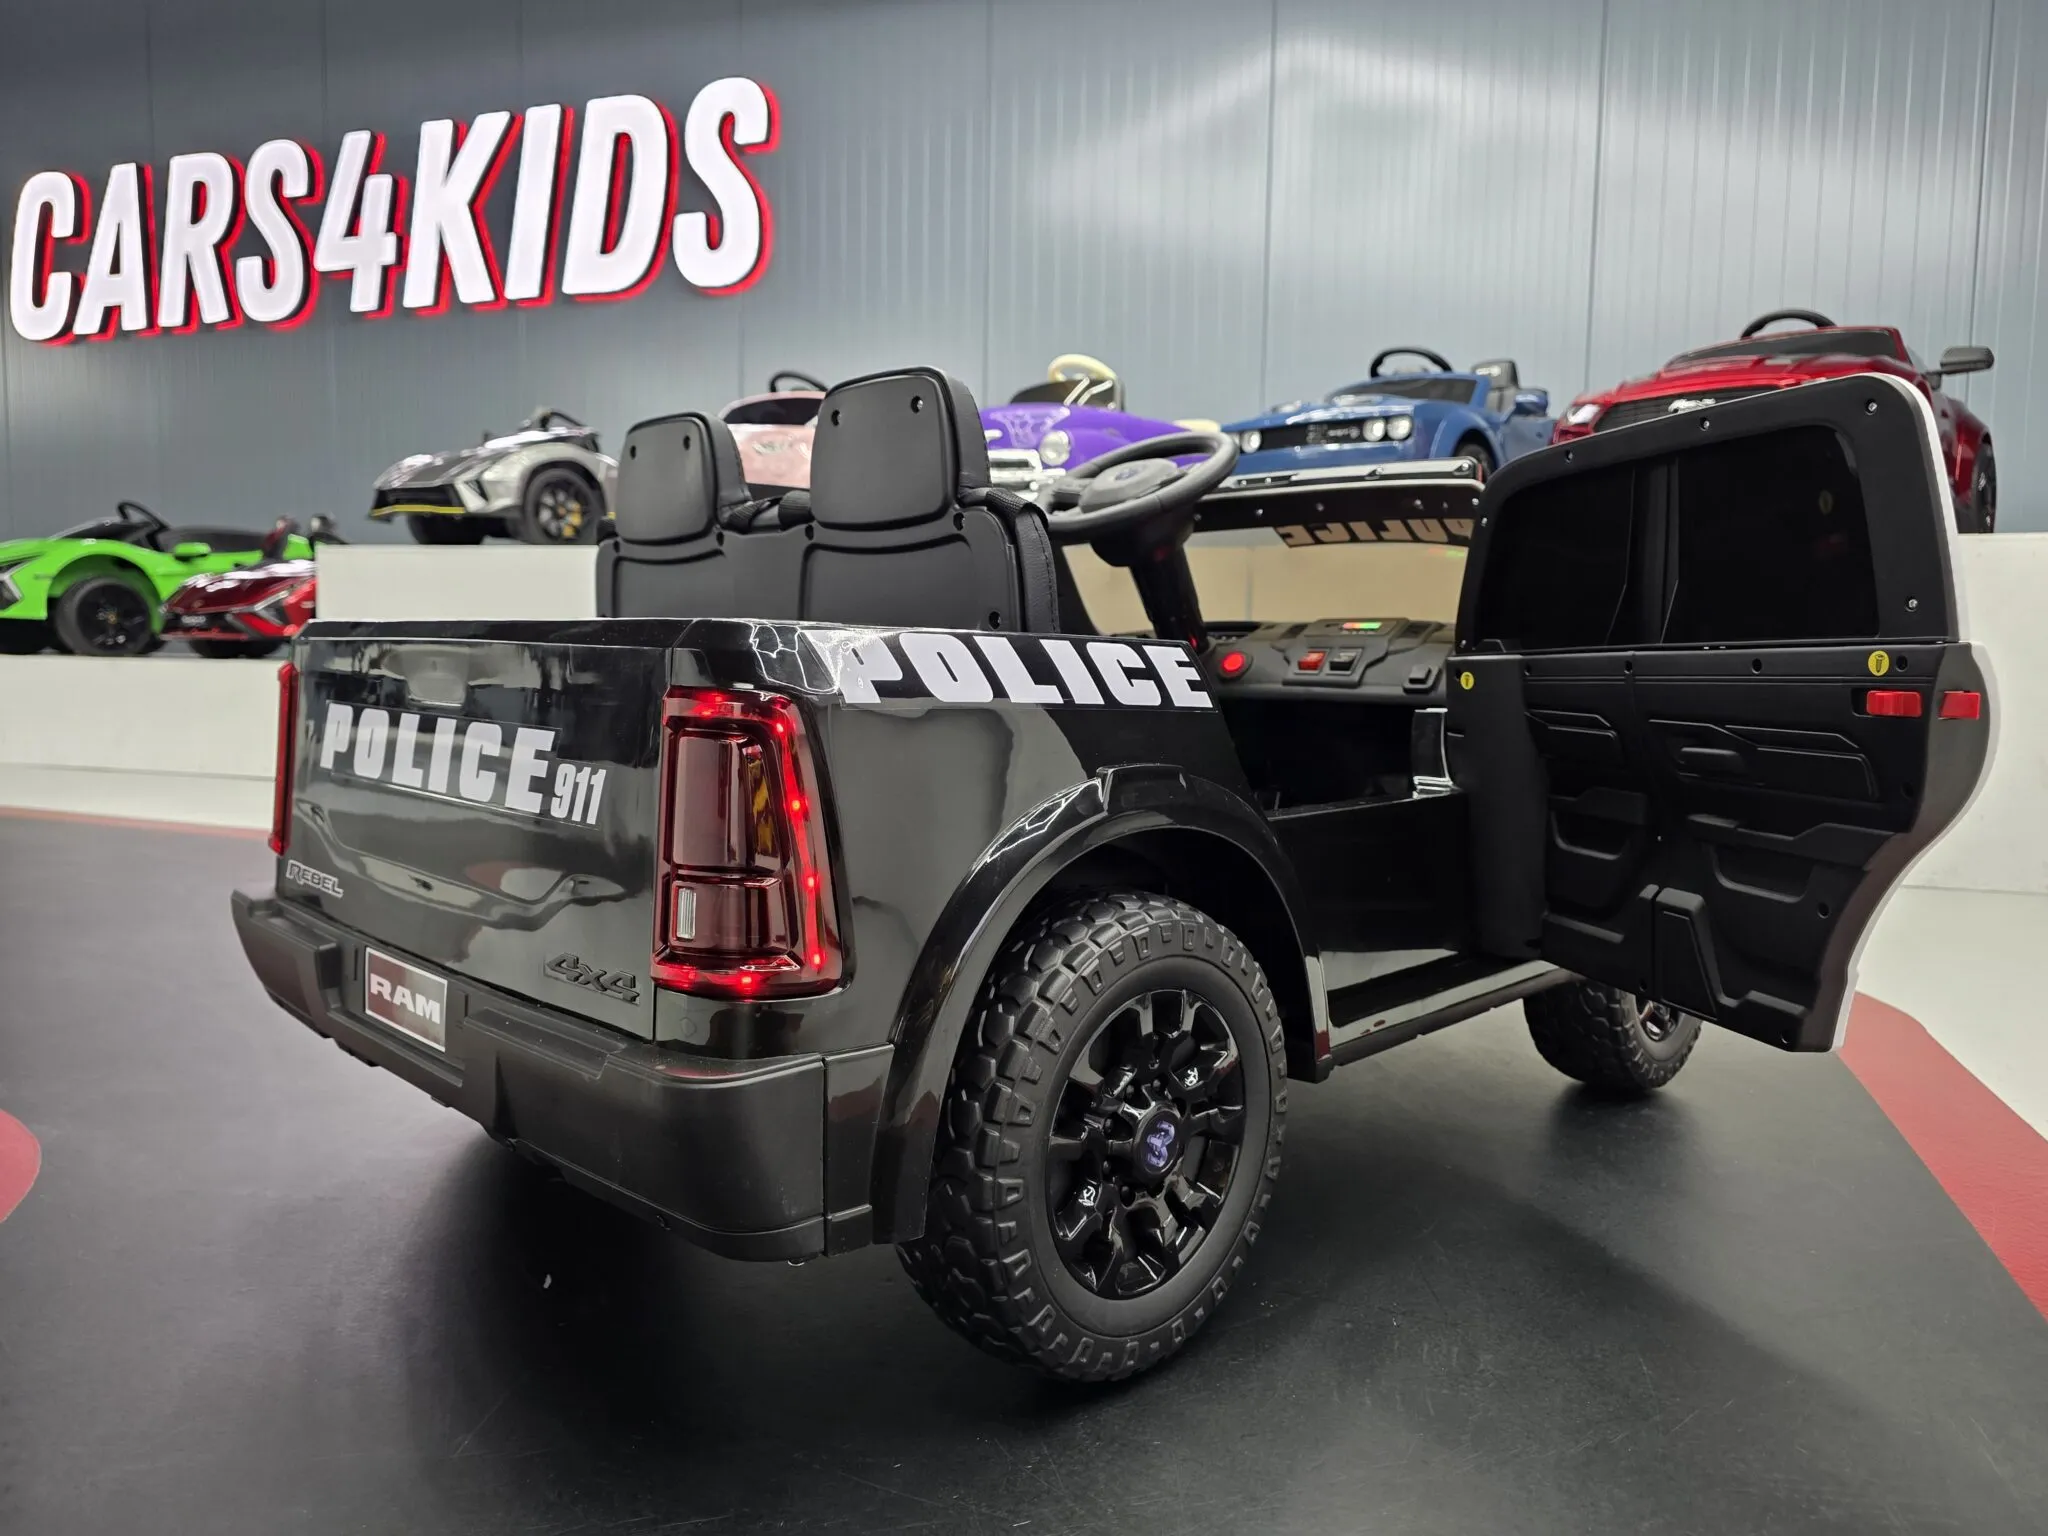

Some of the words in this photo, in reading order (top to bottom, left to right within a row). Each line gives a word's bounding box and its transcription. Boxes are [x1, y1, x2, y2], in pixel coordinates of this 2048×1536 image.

[10, 76, 776, 343] CARS4KIDS
[803, 629, 1213, 708] POLICE
[319, 702, 556, 814] POLICE
[550, 763, 607, 825] 911
[286, 859, 344, 899] REBEL
[369, 972, 441, 1025] RAM
